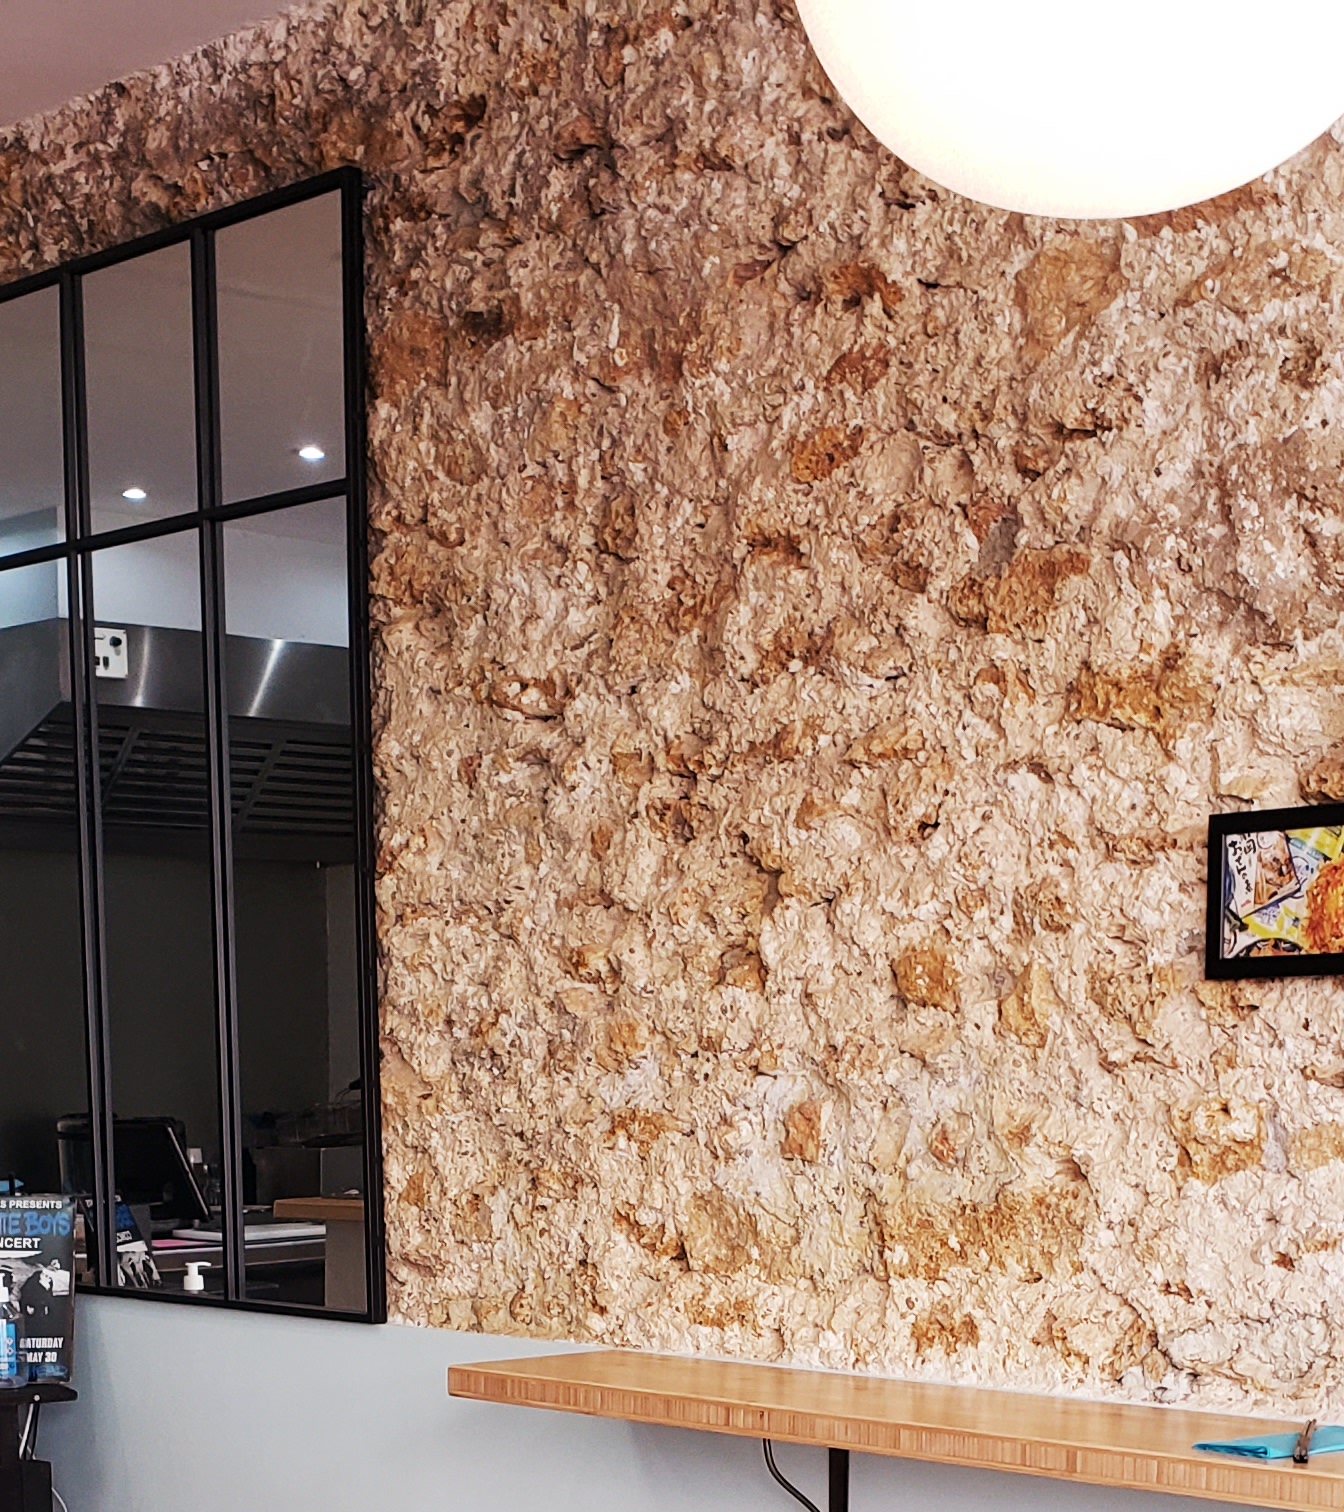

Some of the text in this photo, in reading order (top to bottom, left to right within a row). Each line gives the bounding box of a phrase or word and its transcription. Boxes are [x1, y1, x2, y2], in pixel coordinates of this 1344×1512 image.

[9, 1200, 63, 1209] PRESENTS
[24, 1211, 71, 1236] BOYS
[45, 1352, 58, 1363] 30
